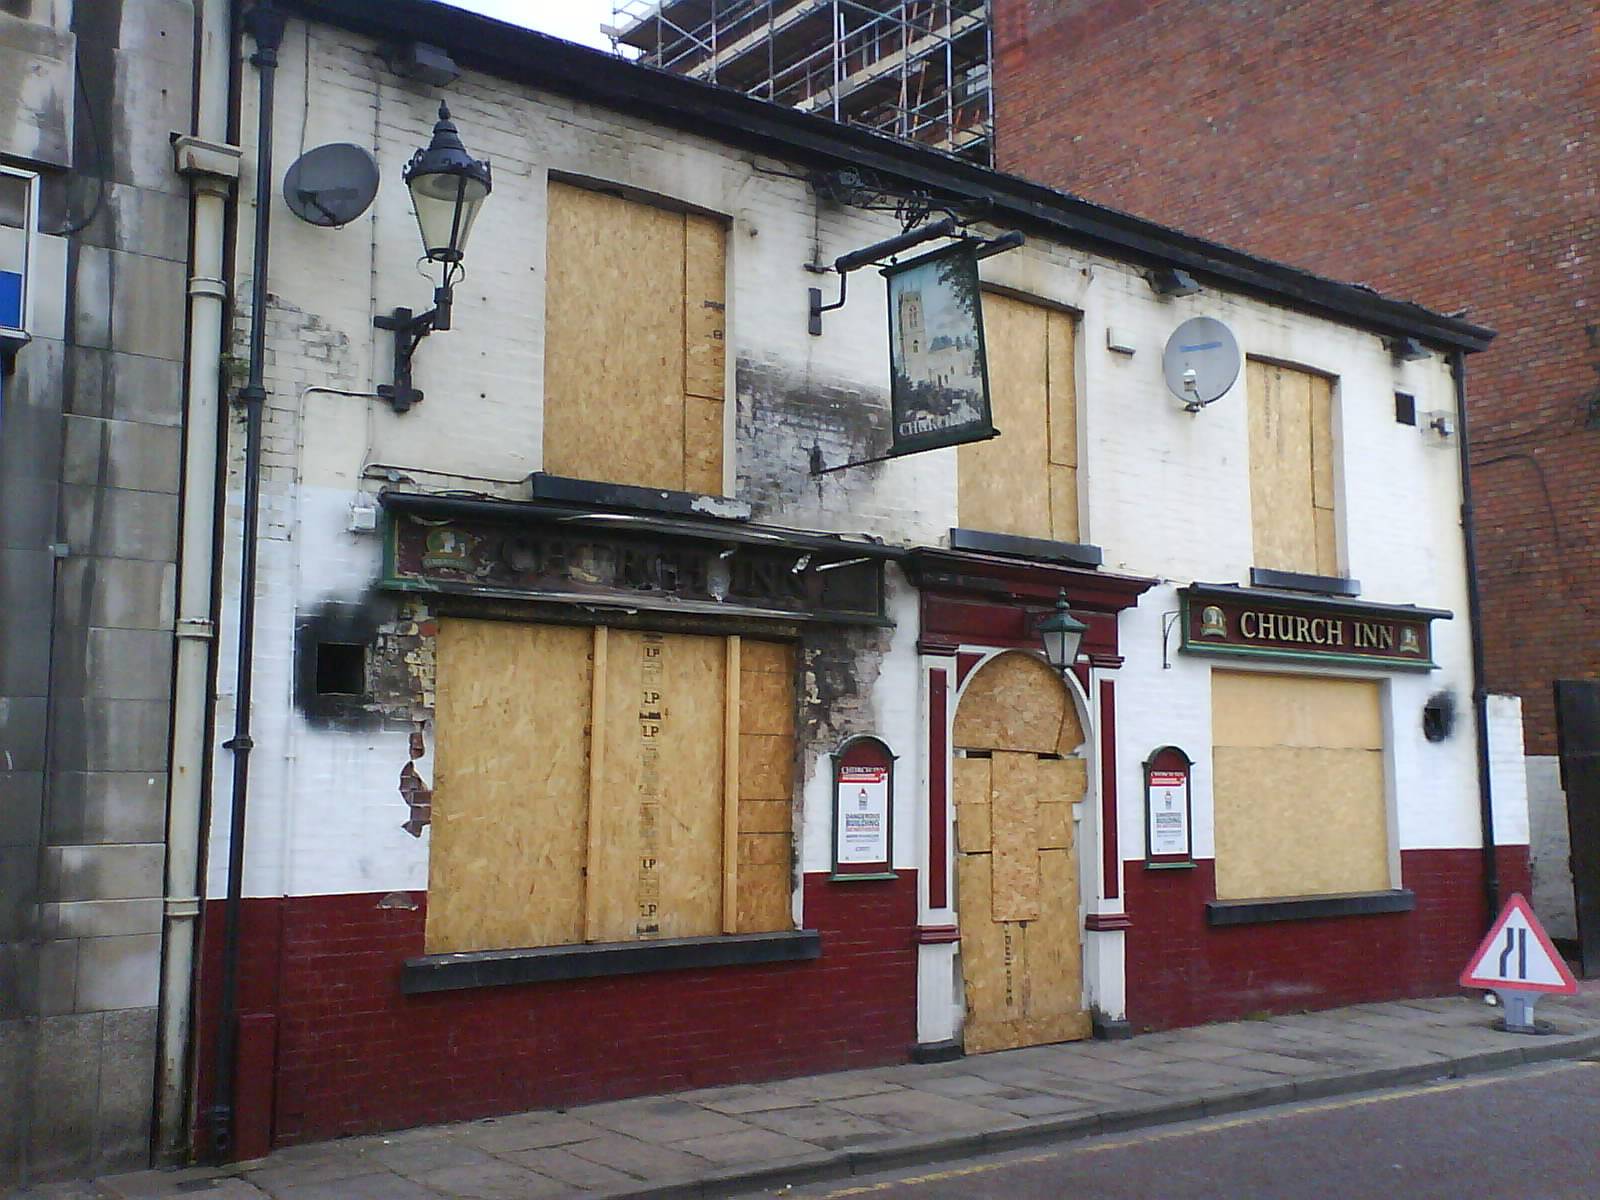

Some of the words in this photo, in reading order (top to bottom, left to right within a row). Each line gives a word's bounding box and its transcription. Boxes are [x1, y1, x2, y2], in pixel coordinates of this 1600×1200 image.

[1240, 611, 1344, 645] CHURCH
[1354, 622, 1394, 649] INN
[646, 648, 660, 657] LP
[644, 691, 660, 704] LP
[642, 725, 659, 737] LP
[643, 859, 656, 868] LP
[640, 904, 656, 917] LP
